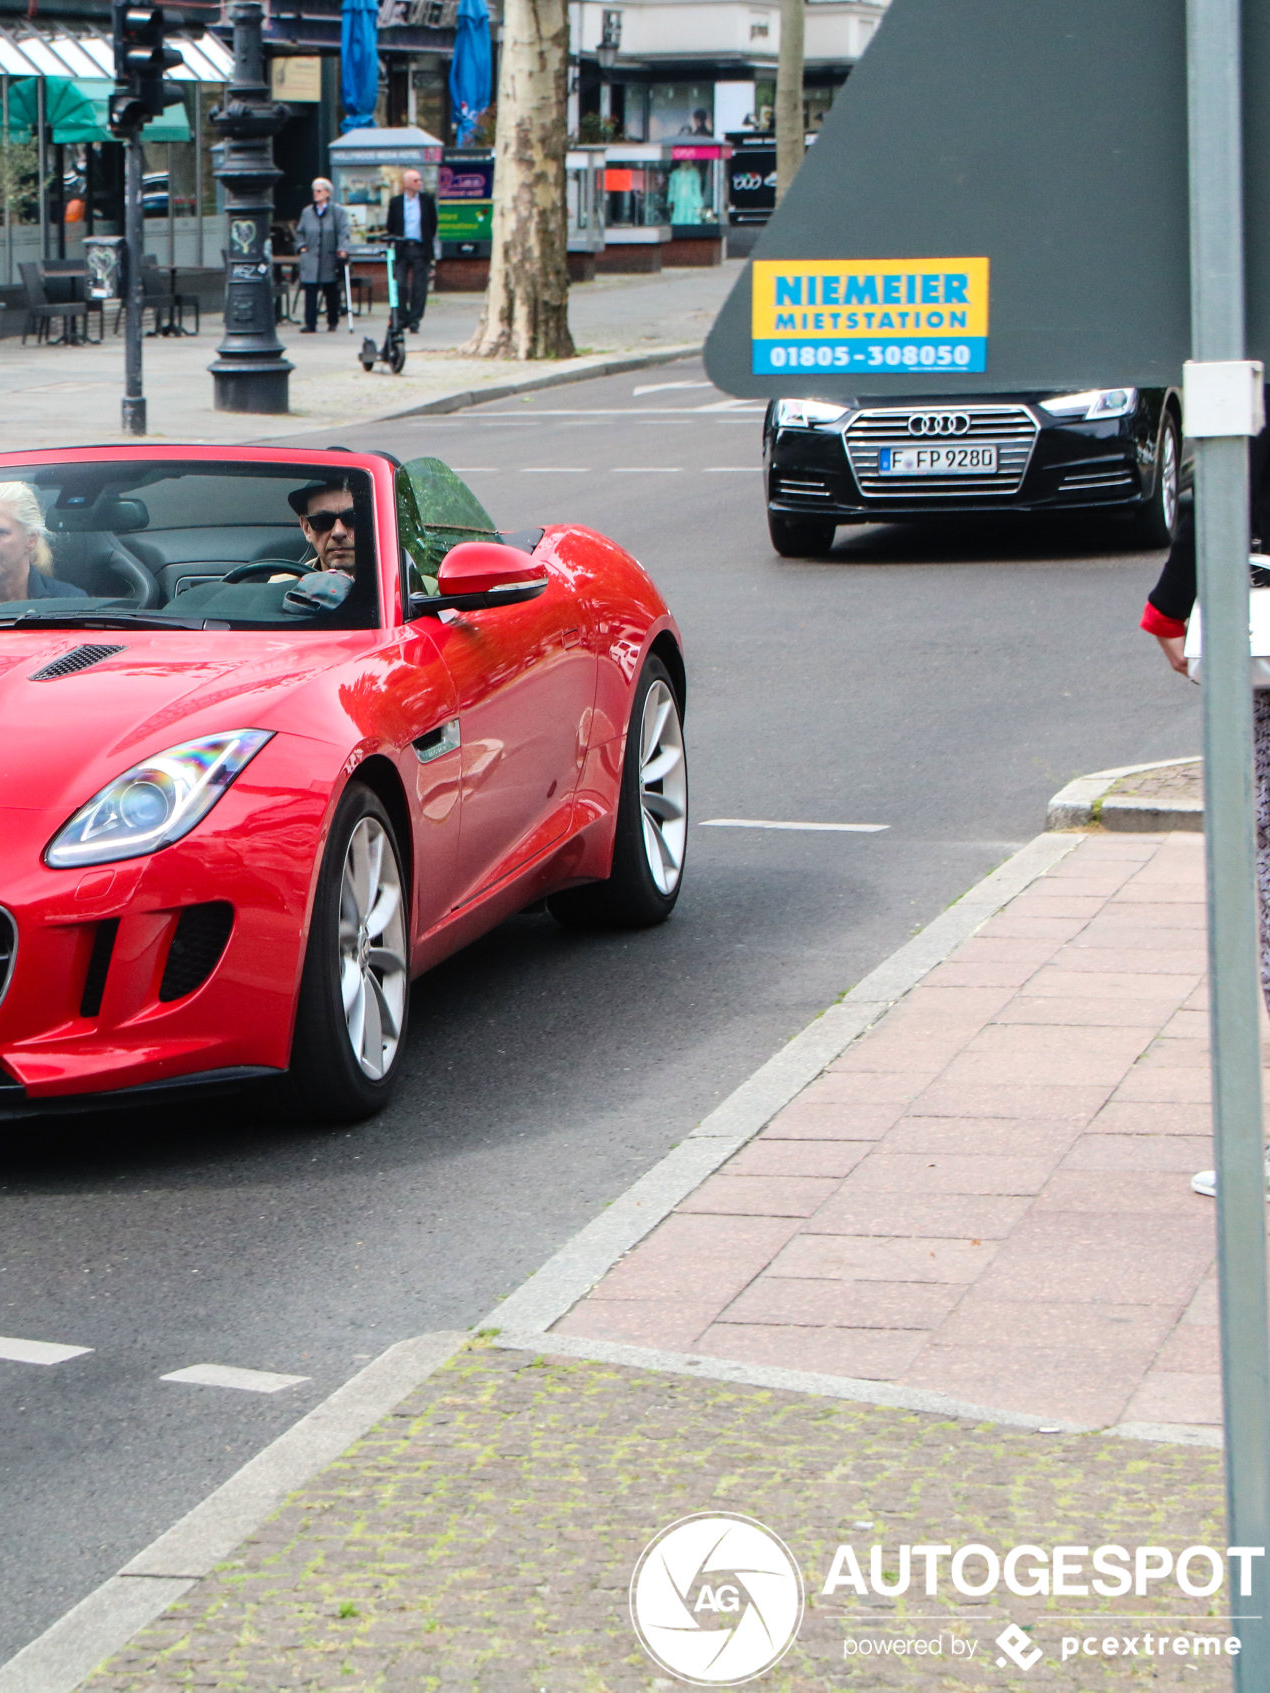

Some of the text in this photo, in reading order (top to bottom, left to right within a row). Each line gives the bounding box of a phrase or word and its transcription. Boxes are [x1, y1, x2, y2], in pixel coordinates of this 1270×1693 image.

[774, 273, 971, 306] NIEMEIER
[774, 311, 967, 330] MIETSTATION
[892, 449, 992, 468] F FP 9280
